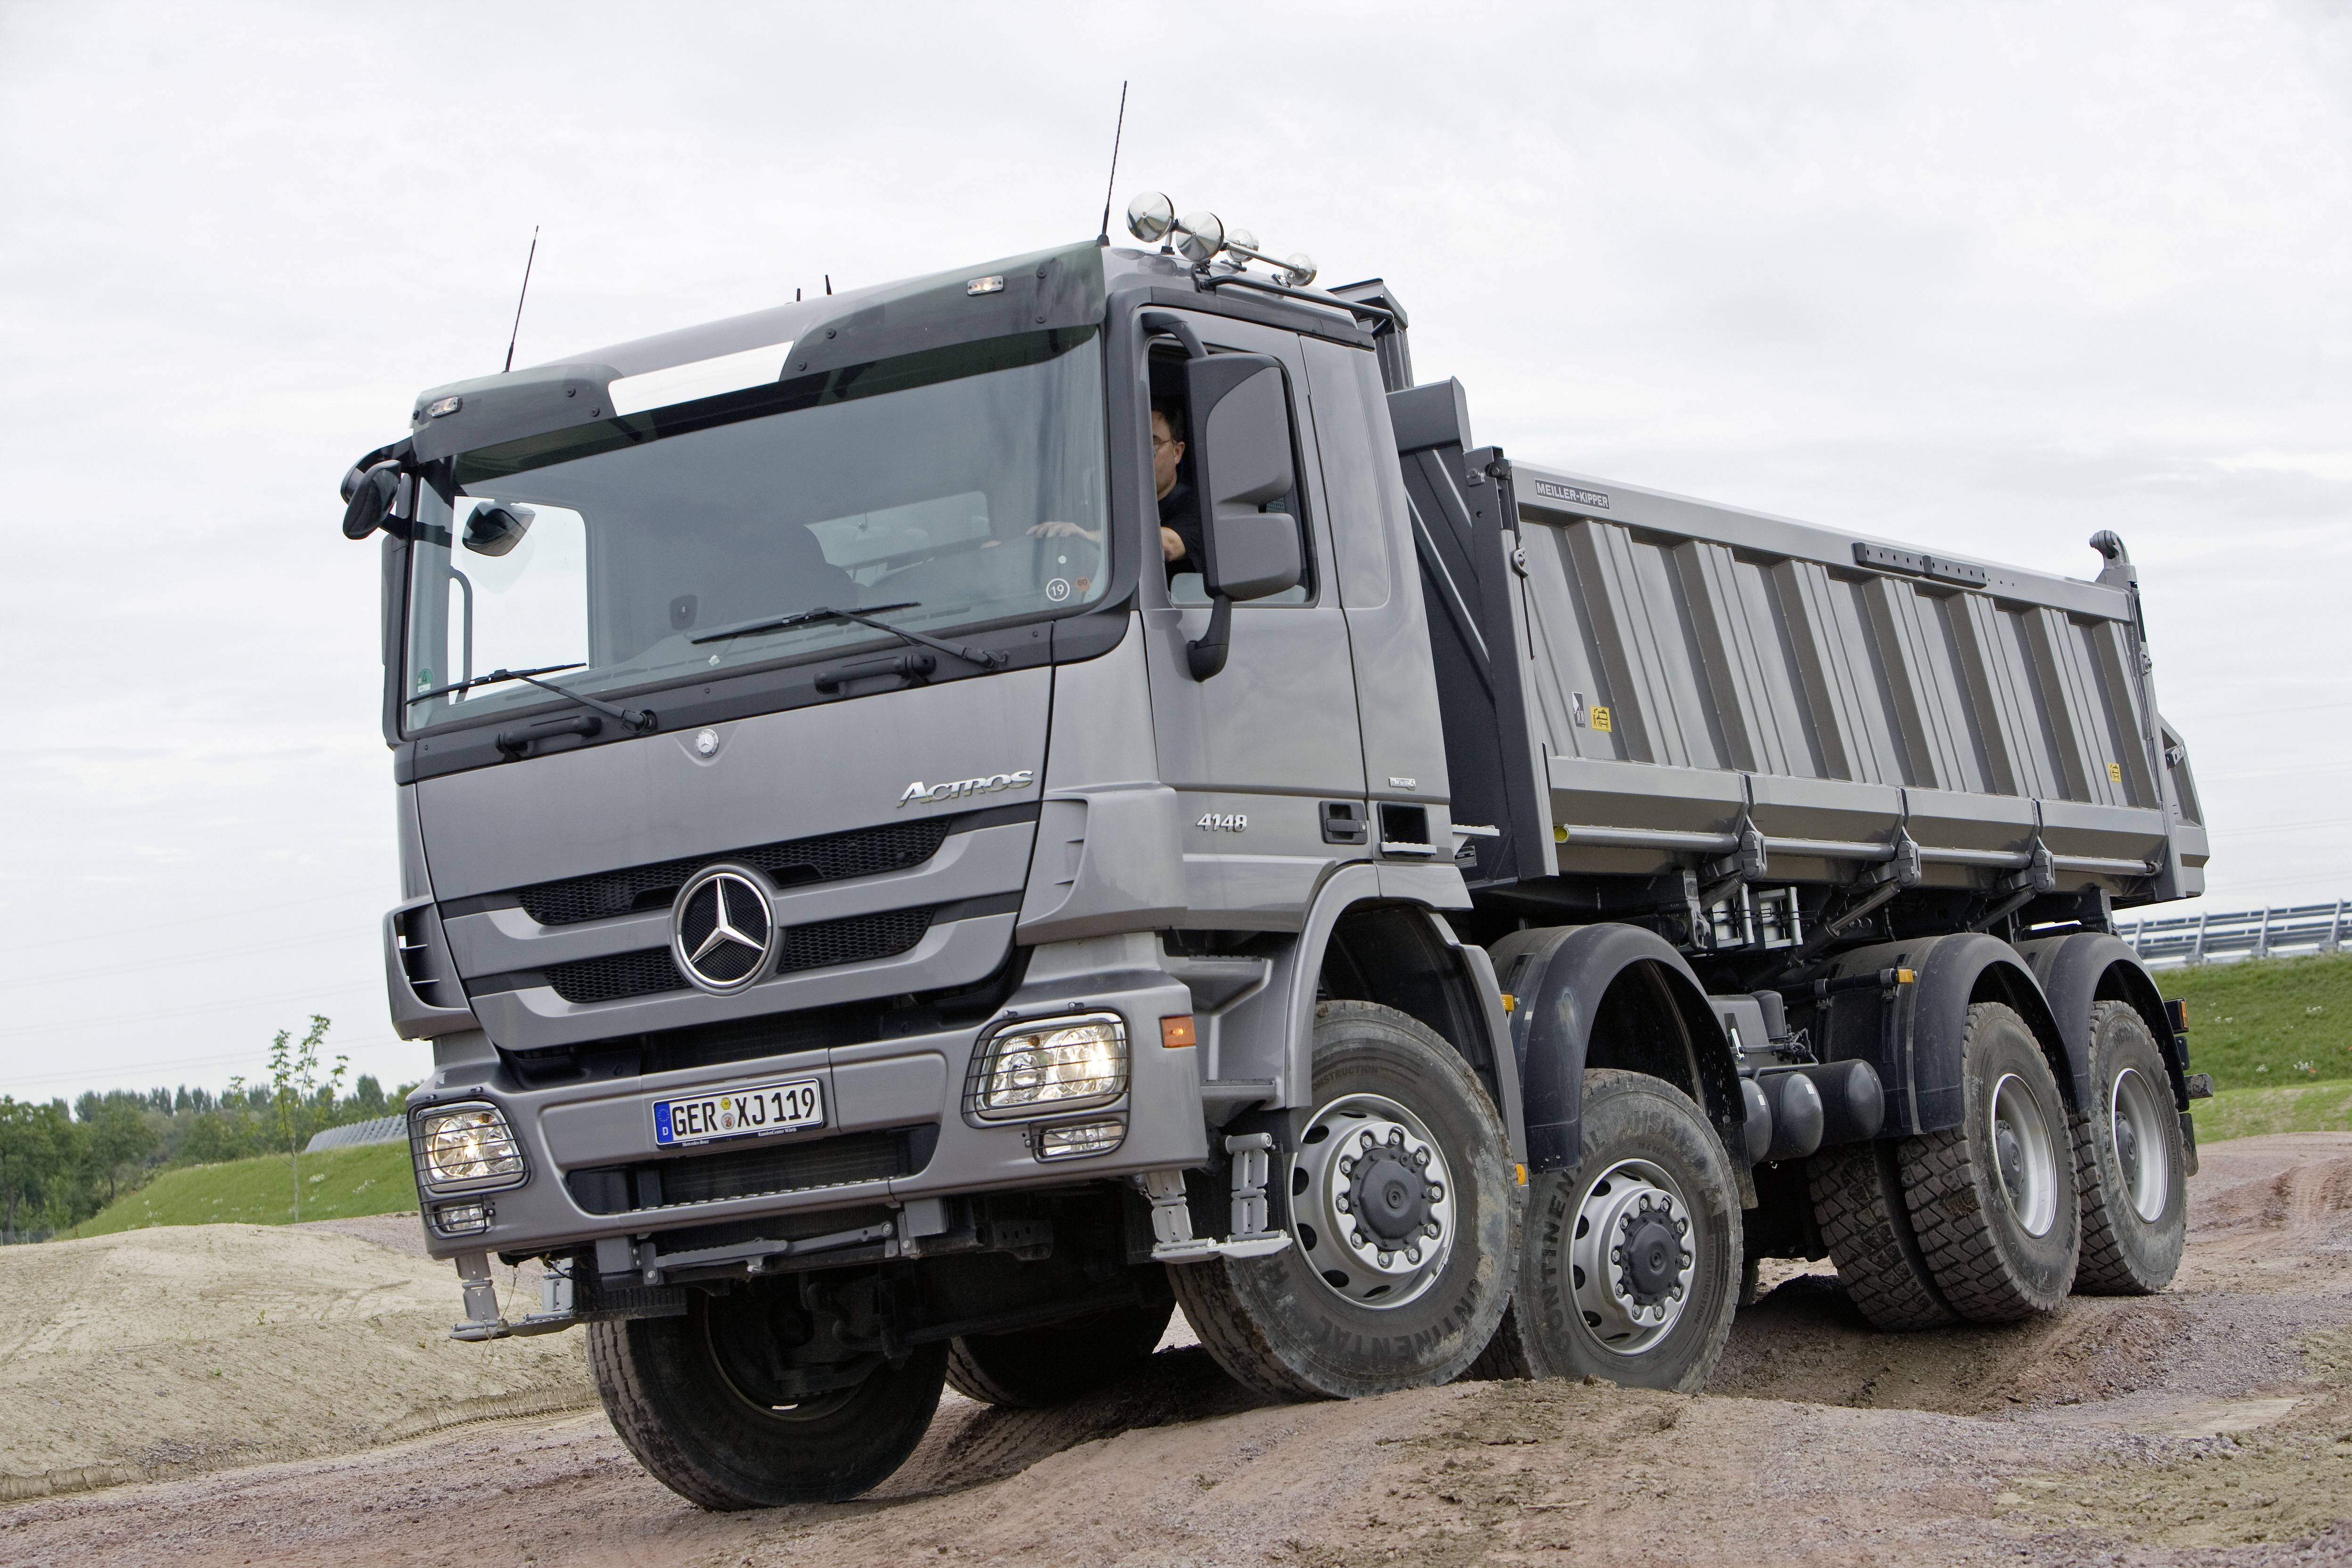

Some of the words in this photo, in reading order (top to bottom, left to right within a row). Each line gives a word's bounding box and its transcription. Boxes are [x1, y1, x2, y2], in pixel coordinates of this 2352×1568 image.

[1536, 482, 1609, 507] MEILLER-KIPPER
[1052, 584, 1064, 596] 19
[1196, 813, 1248, 833] 4148
[1312, 1065, 1379, 1092] ONSTRUCTION
[672, 1102, 718, 1136] GER
[735, 1095, 765, 1127] XJ
[772, 1087, 815, 1123] 119
[662, 1127, 669, 1135] D
[1541, 1130, 1605, 1354] CONTINENAL
[1695, 1235, 1716, 1325] CONSTRUCTION
[1318, 1268, 1489, 1363] ONTINENTAL
